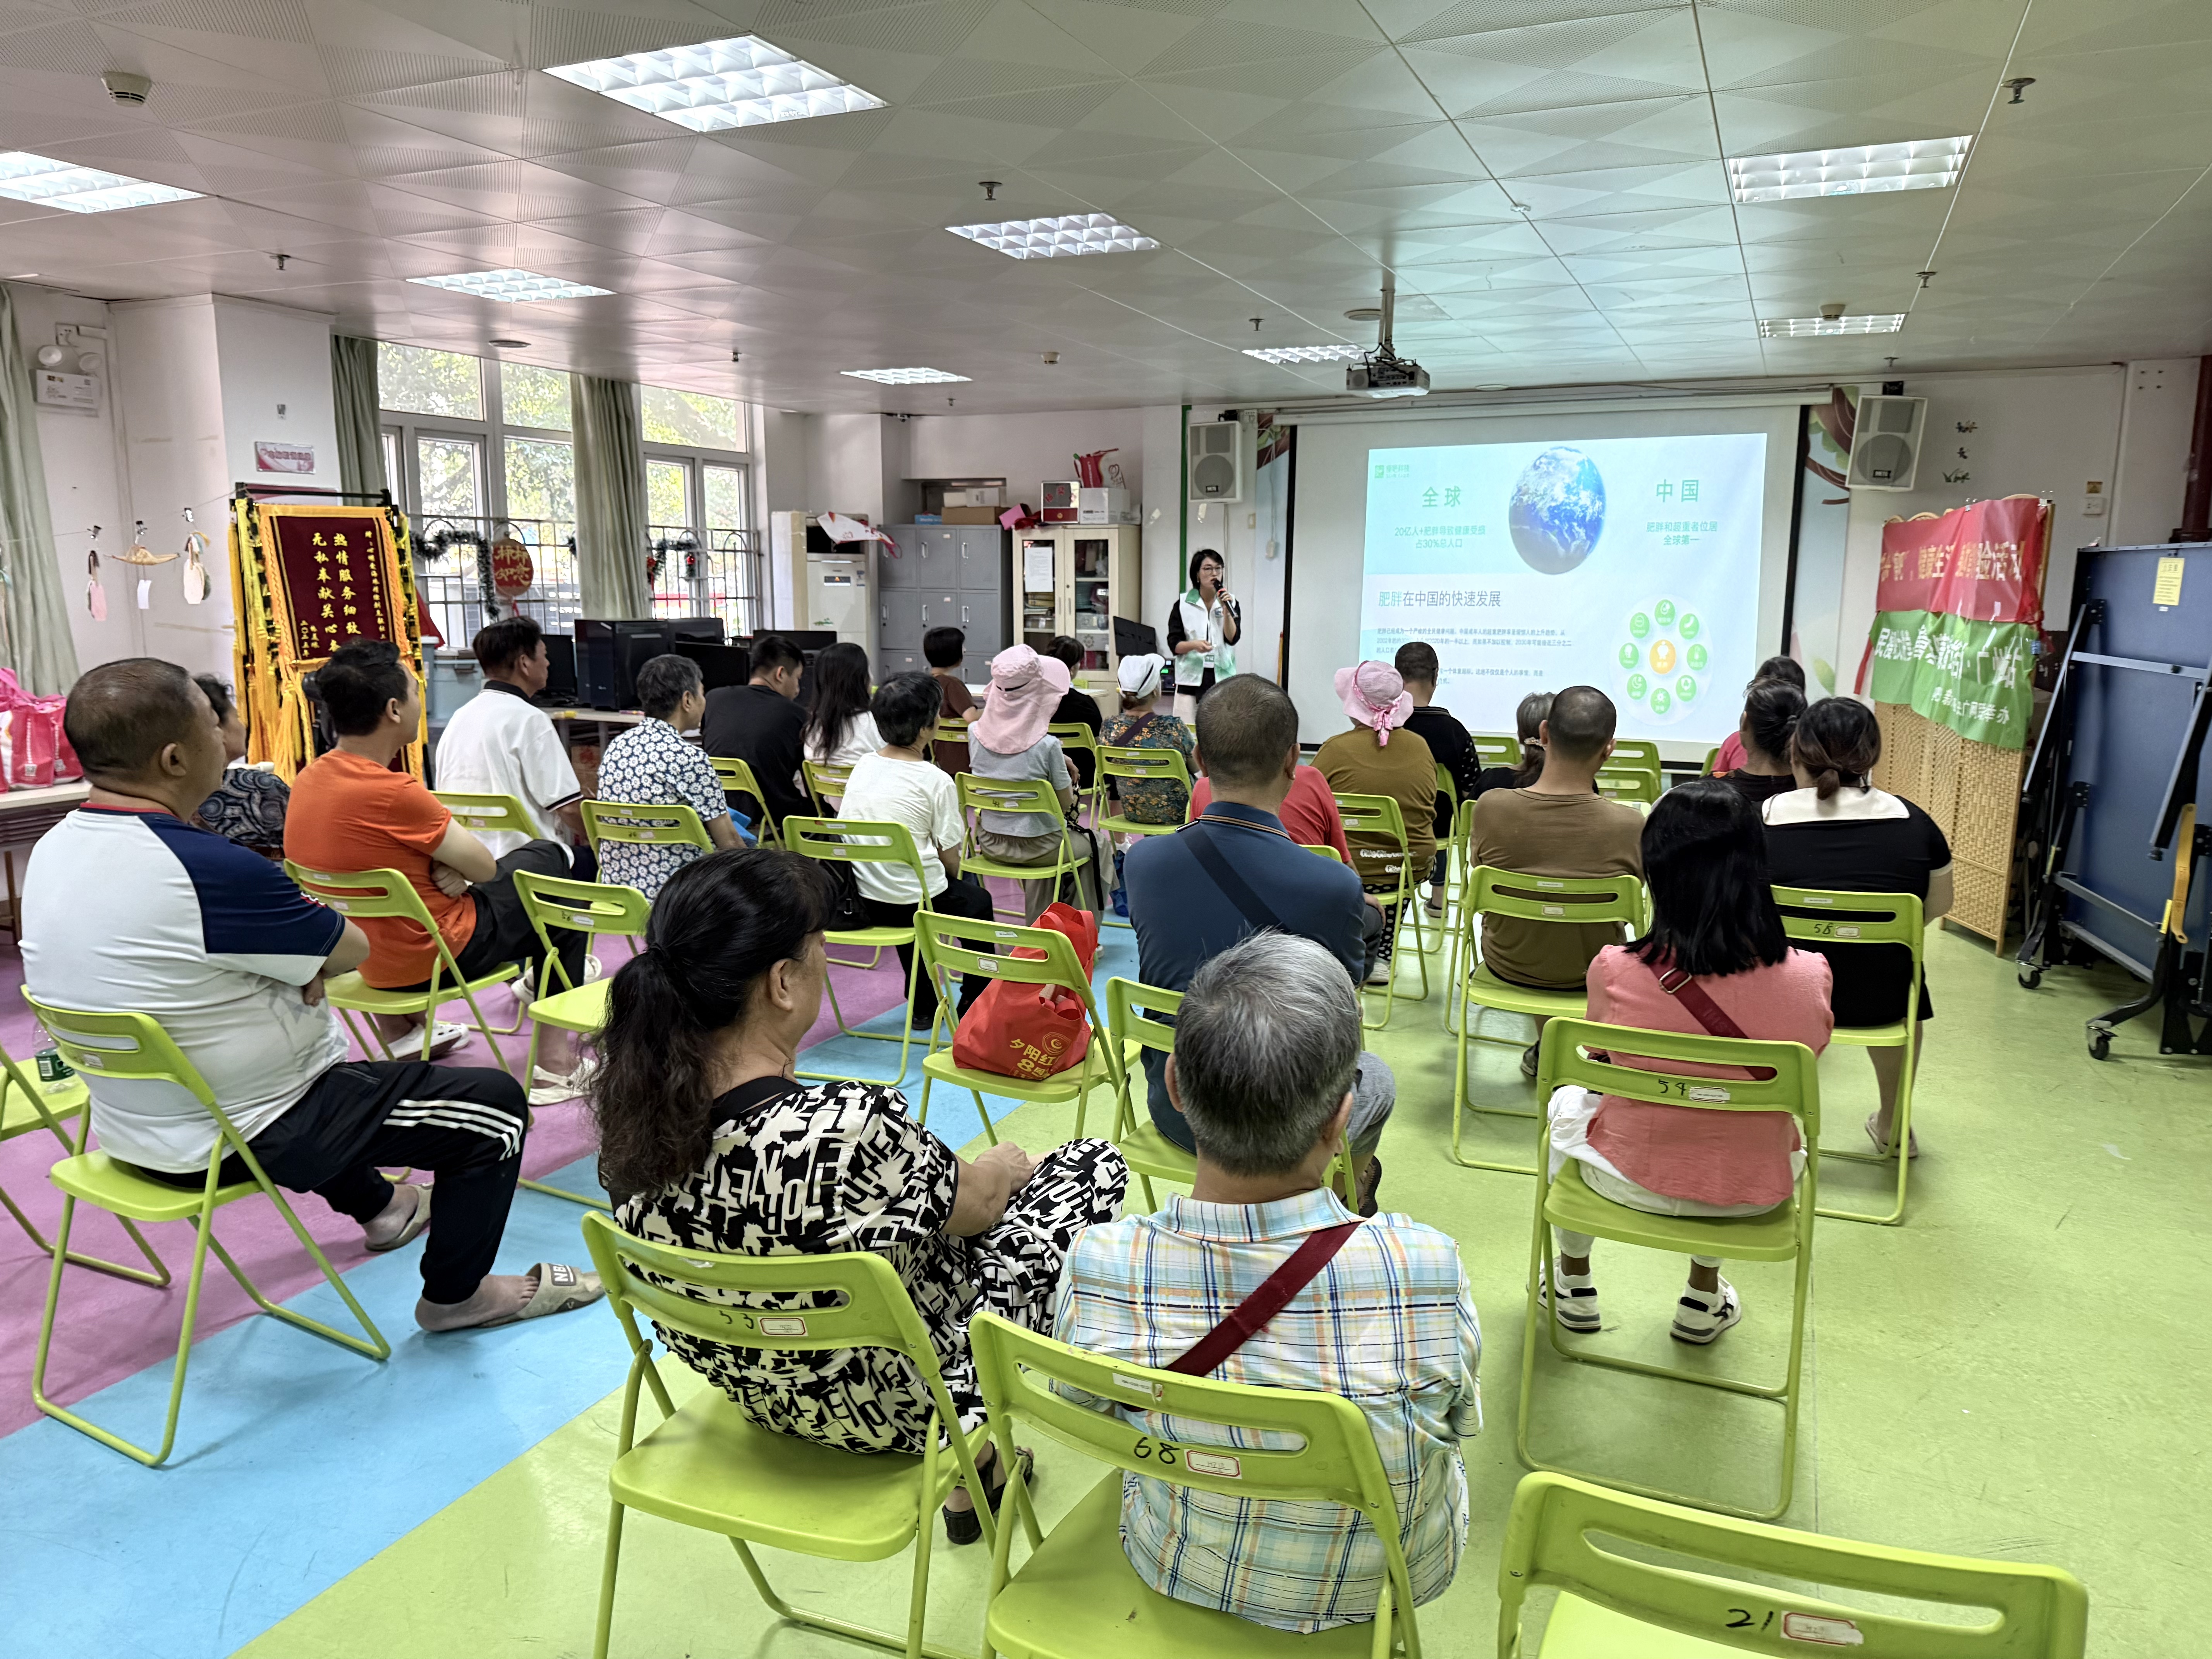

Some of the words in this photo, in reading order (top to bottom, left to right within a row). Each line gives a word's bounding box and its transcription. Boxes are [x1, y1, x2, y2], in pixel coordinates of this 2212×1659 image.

[1422, 486, 1461, 507] 全球
[1656, 479, 1699, 503] 中国
[1395, 525, 1486, 537] 20亿人+肥胖导致健康受损
[1646, 521, 1718, 532] 肥胖和超重者位居
[1415, 539, 1463, 549] 占30%总人口
[1663, 535, 1700, 546] 全球第一
[1379, 590, 1501, 607] 肥胖在中国的快速发展
[1010, 1038, 1057, 1066] 夕阳红
[1658, 1079, 1686, 1096] 54
[1134, 1437, 1180, 1464] 68
[1725, 1608, 1774, 1632] 21
